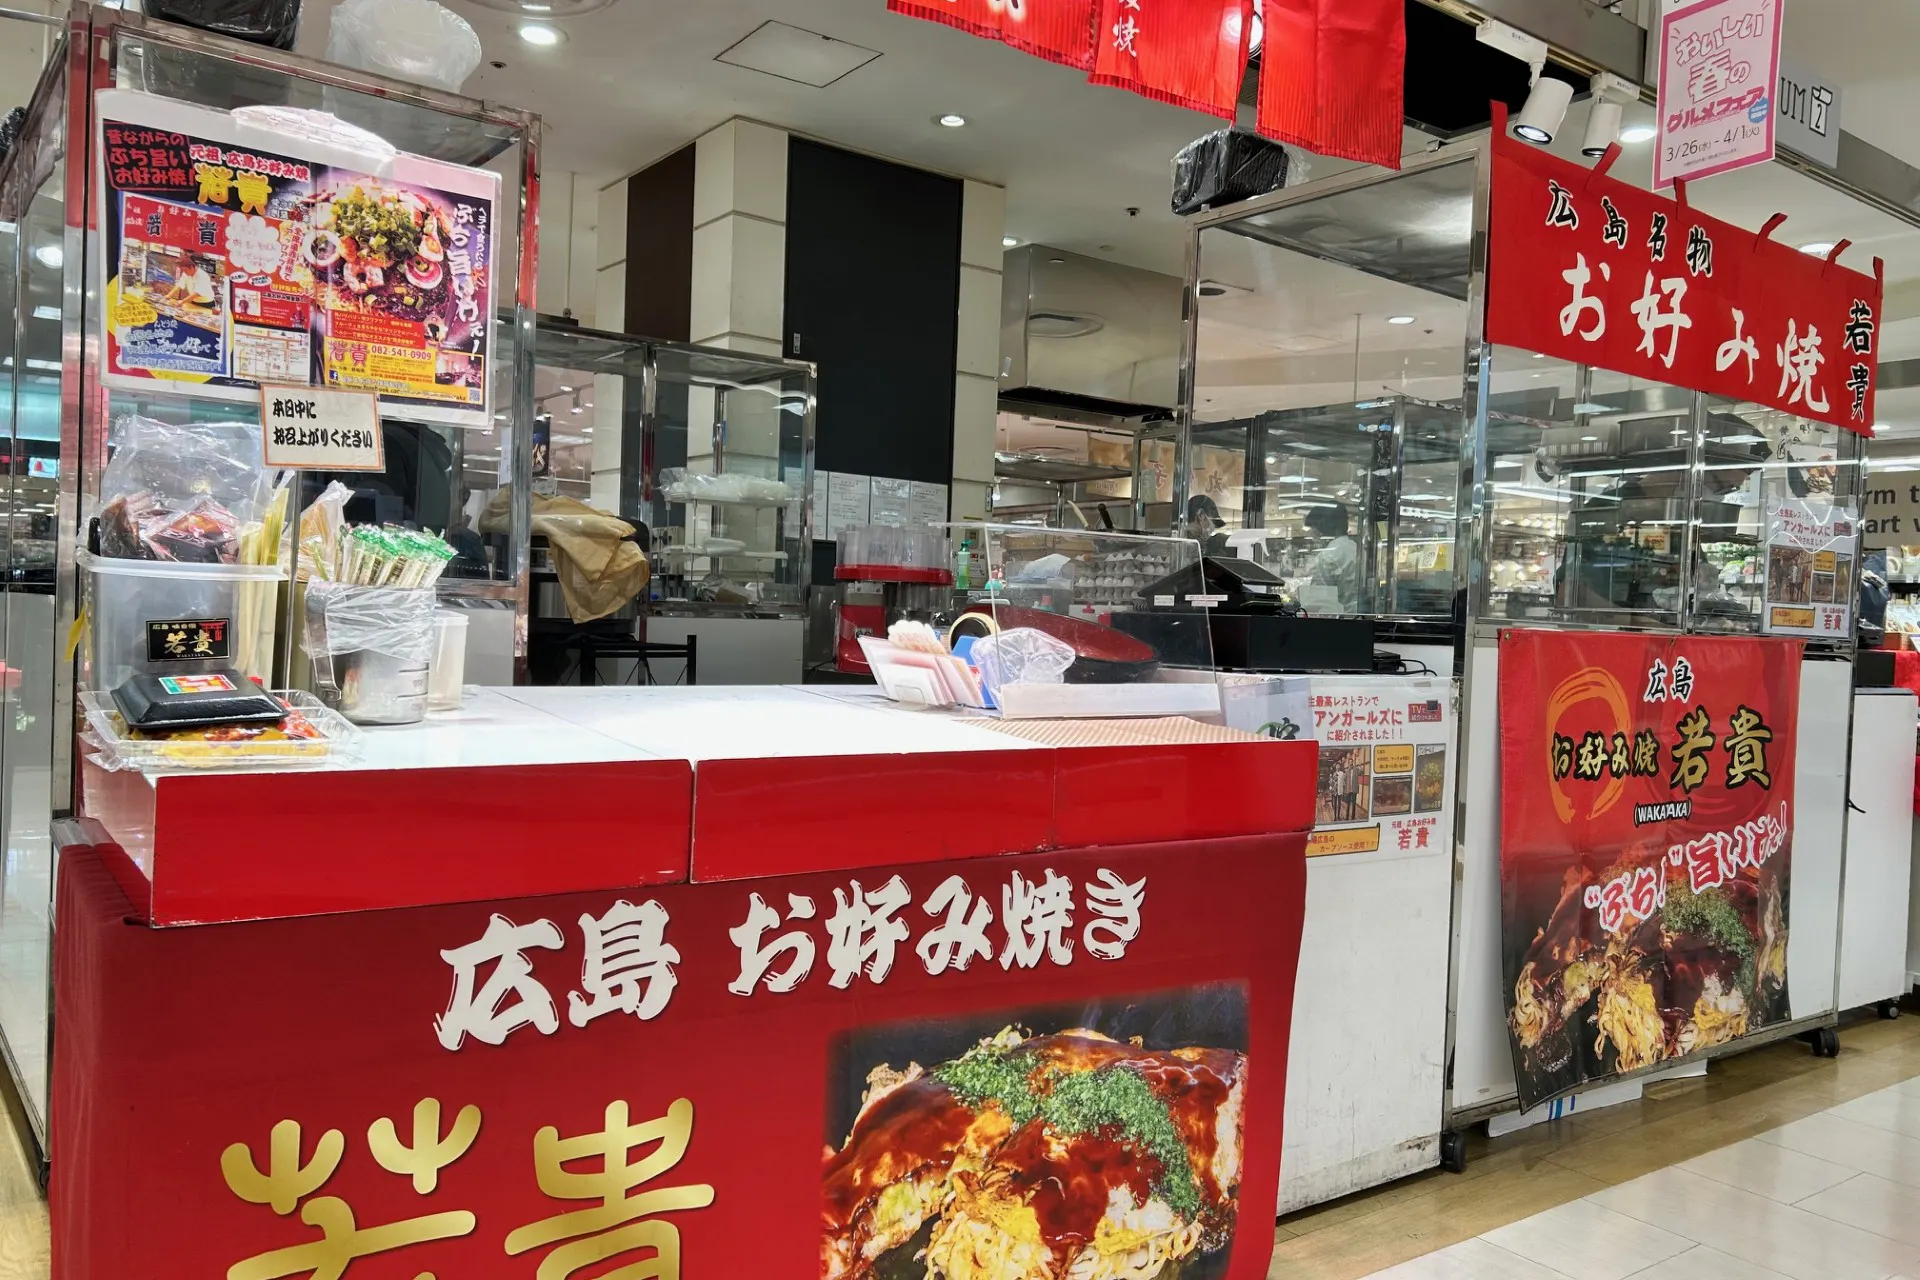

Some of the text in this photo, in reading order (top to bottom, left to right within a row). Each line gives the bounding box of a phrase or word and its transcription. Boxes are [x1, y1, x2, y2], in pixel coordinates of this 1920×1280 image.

[1112, 0, 1140, 57] 焼
[1675, 14, 1764, 66] おいしい
[1688, 49, 1751, 103] 春の
[1667, 86, 1765, 133] グルメフェア
[106, 129, 185, 146] 昔ながらの
[109, 147, 189, 167] ぶち旨い
[1545, 179, 1713, 278] 広島名物
[371, 344, 432, 360] 082-541-0909
[1559, 252, 1830, 413] お好み焼
[1842, 299, 1874, 421] 若貴
[272, 398, 317, 419] 本日中に
[272, 426, 373, 448] お召上がりください
[1643, 656, 1694, 703] 広島
[1314, 708, 1403, 727] アンガールズに
[1551, 705, 1773, 792] お好み焼 若貴
[1398, 827, 1430, 851] 若貴
[433, 867, 1147, 1052] 広島 お好み焼き
